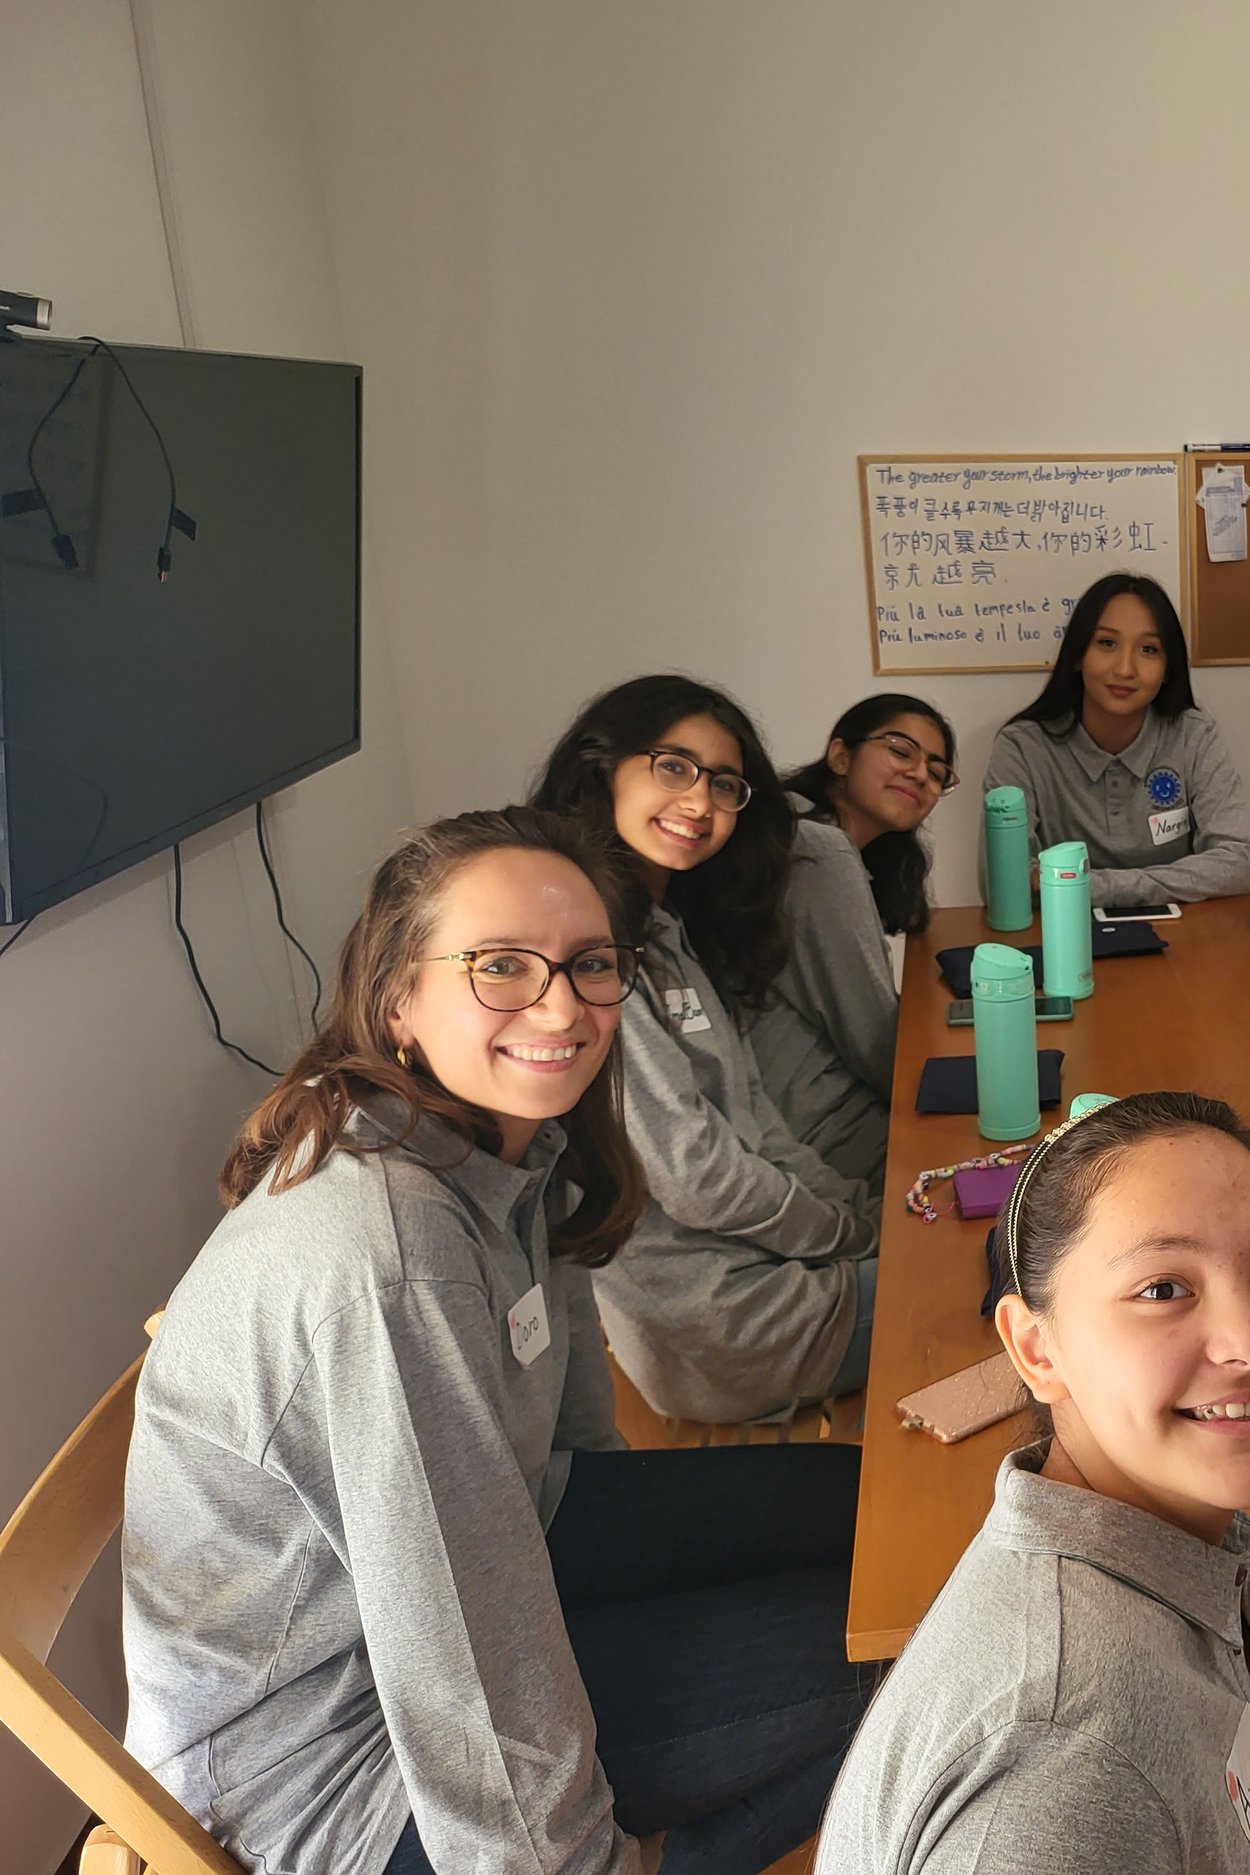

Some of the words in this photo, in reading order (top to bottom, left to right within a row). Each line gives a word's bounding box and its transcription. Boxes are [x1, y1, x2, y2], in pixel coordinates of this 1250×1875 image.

[876, 466, 904, 486] The
[909, 471, 961, 490] greater
[962, 469, 989, 490] your
[989, 470, 1031, 483] storm,
[1032, 466, 1053, 482] the
[1054, 465, 1103, 485] brighter
[1106, 468, 1134, 484] your
[876, 496, 918, 518] 폭풍이
[924, 498, 962, 521] 클수록
[1042, 598, 1050, 612] è
[908, 627, 967, 644] luminoso
[975, 628, 984, 642] è
[997, 623, 1006, 642] il
[516, 1316, 538, 1350] Doro
